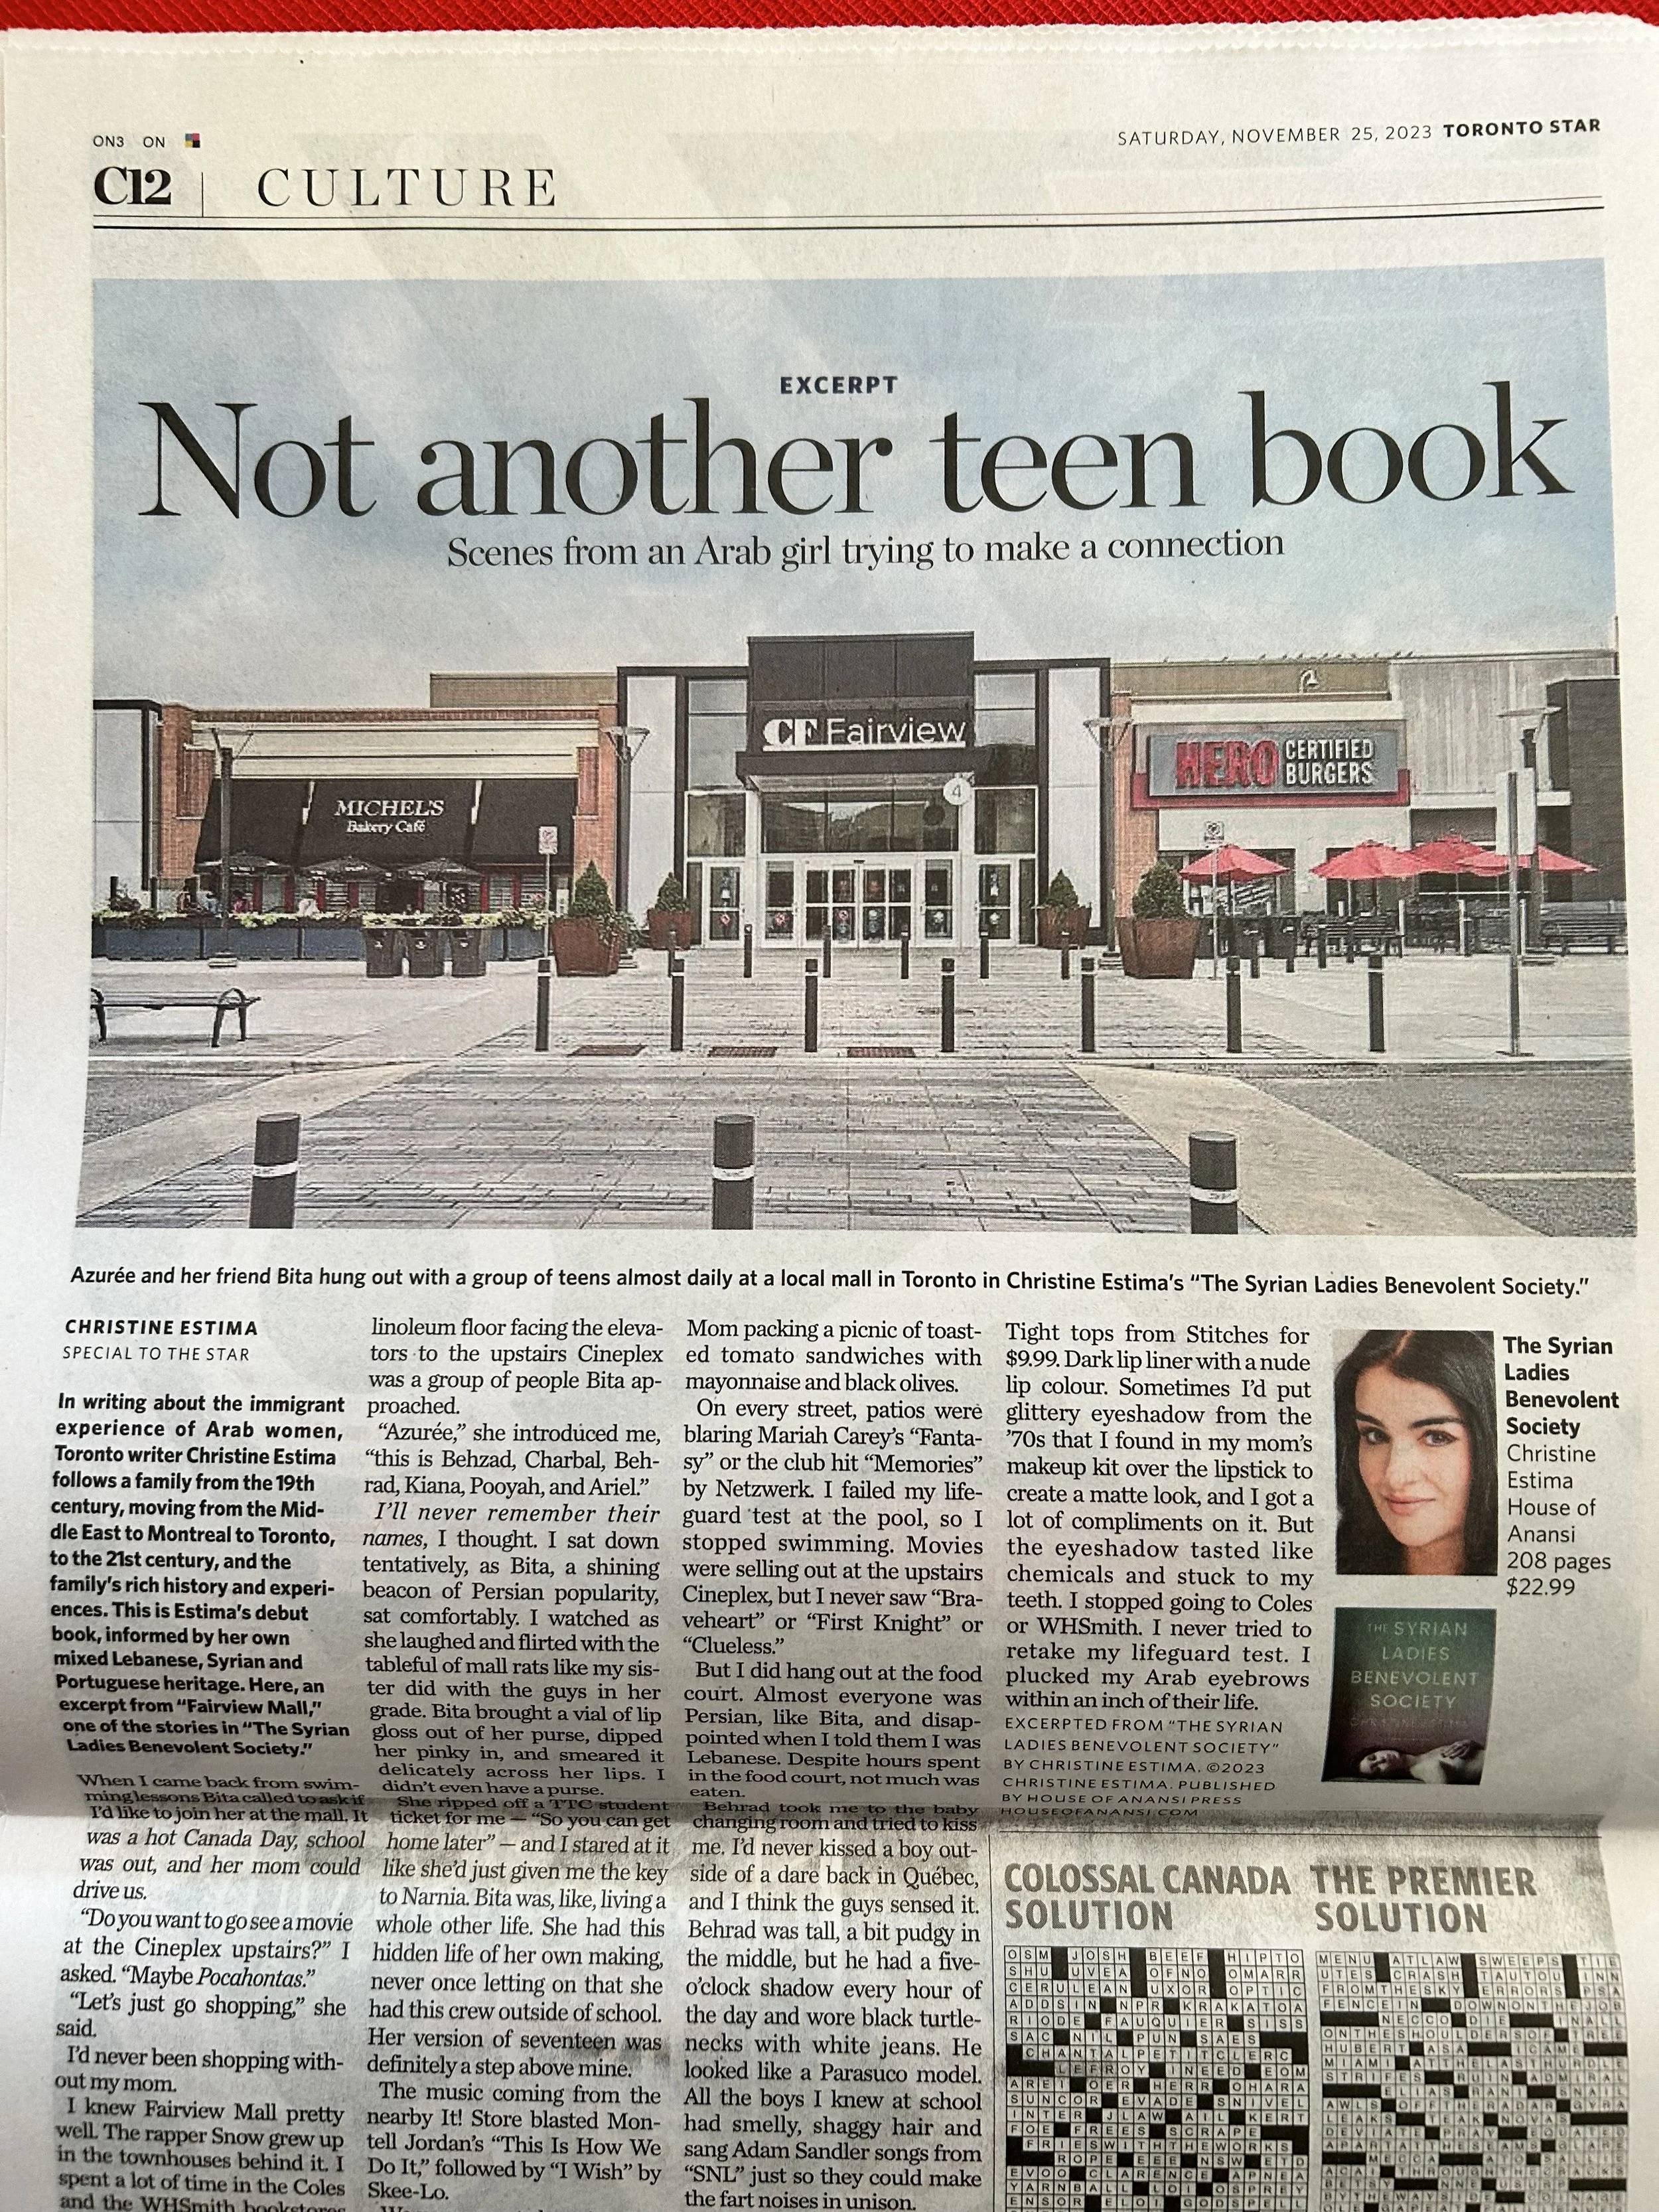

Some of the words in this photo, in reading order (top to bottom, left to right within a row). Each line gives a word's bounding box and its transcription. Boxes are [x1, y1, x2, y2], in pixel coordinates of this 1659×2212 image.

[94, 135, 123, 147] ON3
[143, 137, 165, 147] ON
[1119, 131, 1224, 145] SATURDAY,
[1233, 128, 1339, 143] NOVEMBER
[1352, 127, 1377, 141] 25,
[1386, 125, 1431, 139] 2023
[1443, 121, 1542, 137] TORONTO
[1550, 119, 1600, 133] STAR
[94, 167, 171, 204] C12
[258, 169, 554, 206] CULTURE
[781, 376, 898, 394] EXCERPT
[138, 402, 376, 518] Not
[417, 398, 893, 516] another
[929, 412, 1206, 513] teen
[1238, 381, 1575, 507] book
[449, 538, 553, 566] Scenes
[564, 536, 638, 565] from
[649, 546, 685, 564] an
[694, 536, 770, 565] Arab
[782, 536, 831, 572] girl
[843, 536, 934, 571] trying
[943, 538, 974, 562] to
[985, 532, 1069, 561] make
[1081, 540, 1097, 559] a
[1108, 529, 1283, 558] connection
[826, 717, 966, 745] Fairview
[1285, 739, 1374, 760] CERTIFIED
[1175, 740, 1279, 788] HERO
[1285, 762, 1374, 785] BURGERS
[334, 800, 445, 816] MICHEL'S
[70, 1266, 135, 1283] Azurée
[141, 1267, 175, 1283] and
[181, 1267, 210, 1283] her
[216, 1267, 271, 1284] friend
[278, 1268, 312, 1284] Bita
[320, 1268, 366, 1288] hung
[372, 1270, 402, 1284] out
[409, 1268, 449, 1284] with
[456, 1273, 465, 1285] a
[472, 1273, 527, 1289] group
[534, 1268, 553, 1285] of
[559, 1270, 610, 1285] teens
[617, 1268, 681, 1285] almost
[687, 1269, 733, 1290] daily
[739, 1270, 757, 1286] at
[764, 1274, 774, 1286] a
[782, 1269, 824, 1286] local
[832, 1270, 871, 1286] mall
[879, 1270, 895, 1287] in
[902, 1271, 975, 1288] Toronto
[983, 1272, 999, 1288] in
[1007, 1272, 1095, 1290] Christine
[1246, 1275, 1307, 1295] Syrian
[1315, 1276, 1378, 1293] Ladies
[1386, 1276, 1495, 1294] Benevolent
[66, 1319, 173, 1334] CHRISTINE
[180, 1321, 257, 1335] ESTIMA
[372, 1317, 456, 1335] linoleum
[461, 1318, 506, 1335] floor
[511, 1318, 568, 1340] facing
[572, 1318, 603, 1335] the
[608, 1318, 663, 1336] eleva-
[687, 1319, 738, 1336] Mom
[744, 1319, 818, 1342] packing
[824, 1325, 834, 1337] a
[839, 1321, 897, 1341] picnic
[903, 1321, 923, 1338] of
[927, 1323, 981, 1339] toast-
[63, 1347, 131, 1359] SPECIAL
[139, 1347, 161, 1360] TO
[168, 1348, 200, 1360] THE
[207, 1348, 248, 1361] STAR
[1503, 1336, 1541, 1353] The
[1548, 1337, 1613, 1358] Syrian
[1006, 1349, 1059, 1367] $9.99.
[1064, 1350, 1114, 1367] Dark
[1117, 1351, 1141, 1372] lip
[1146, 1351, 1192, 1369] liner
[1196, 1352, 1241, 1370] with
[1246, 1358, 1256, 1370] a
[1260, 1353, 1310, 1370] nude
[1505, 1363, 1569, 1380] Ladies
[1506, 1390, 1619, 1408] Benevolent
[1507, 1417, 1580, 1439] Society
[54, 1445, 123, 1461] Toronto
[128, 1446, 182, 1462] writer
[187, 1447, 269, 1464] Christine
[274, 1448, 335, 1465] Estima
[1508, 1444, 1595, 1462] Christine
[1508, 1471, 1572, 1489] Estima
[1509, 1498, 1569, 1516] House
[1577, 1499, 1595, 1516] of
[1508, 1525, 1574, 1542] Anansi
[1508, 1552, 1546, 1569] 208
[1555, 1557, 1611, 1573] pages
[1507, 1577, 1575, 1597] $22.99
[1367, 1623, 1388, 1633] THE
[1394, 1621, 1468, 1637] SYRIAN
[1382, 1646, 1450, 1660] LADIES
[1351, 1670, 1479, 1686] BENEVOLENT
[1370, 1694, 1457, 1709] SOCIETY
[1006, 1718, 1106, 1730] EXCERPTED
[1113, 1720, 1162, 1731] FROM
[1216, 1721, 1281, 1733] SYRIAN
[1005, 1739, 1066, 1750] LADIES
[1072, 1741, 1188, 1753] BENEVOLENT
[1005, 1759, 1024, 1769] BY
[1030, 1760, 1123, 1771] CHRISTINE
[1129, 1762, 1200, 1772] ESTIMA.
[1003, 1778, 1096, 1788] CHRISTINE
[1102, 1780, 1172, 1789] ESTIMA.
[1179, 1781, 1275, 1791] PUBLISHED
[1005, 1863, 1155, 1893] COLOSSAL
[1163, 1865, 1291, 1895] CANADA
[1310, 1863, 1376, 1894] THE
[1387, 1864, 1537, 1896] PREMIER
[1006, 1899, 1173, 1931] SOLUTION
[1315, 1901, 1487, 1933] SOLUTION
[61, 1963, 116, 1983] asked.
[685, 2059, 749, 2079] looked
[758, 2061, 792, 2080] like
[801, 2068, 812, 2081] a
[821, 2063, 907, 2083] Parasuco
[916, 2065, 981, 2085] model.
[68, 2097, 74, 2113] I
[86, 2097, 135, 2116] knew
[145, 2100, 225, 2118] Fairview
[234, 2103, 277, 2121] Mall
[287, 2106, 344, 2127] pretty
[368, 2181, 449, 2200] Skee-Lo.
